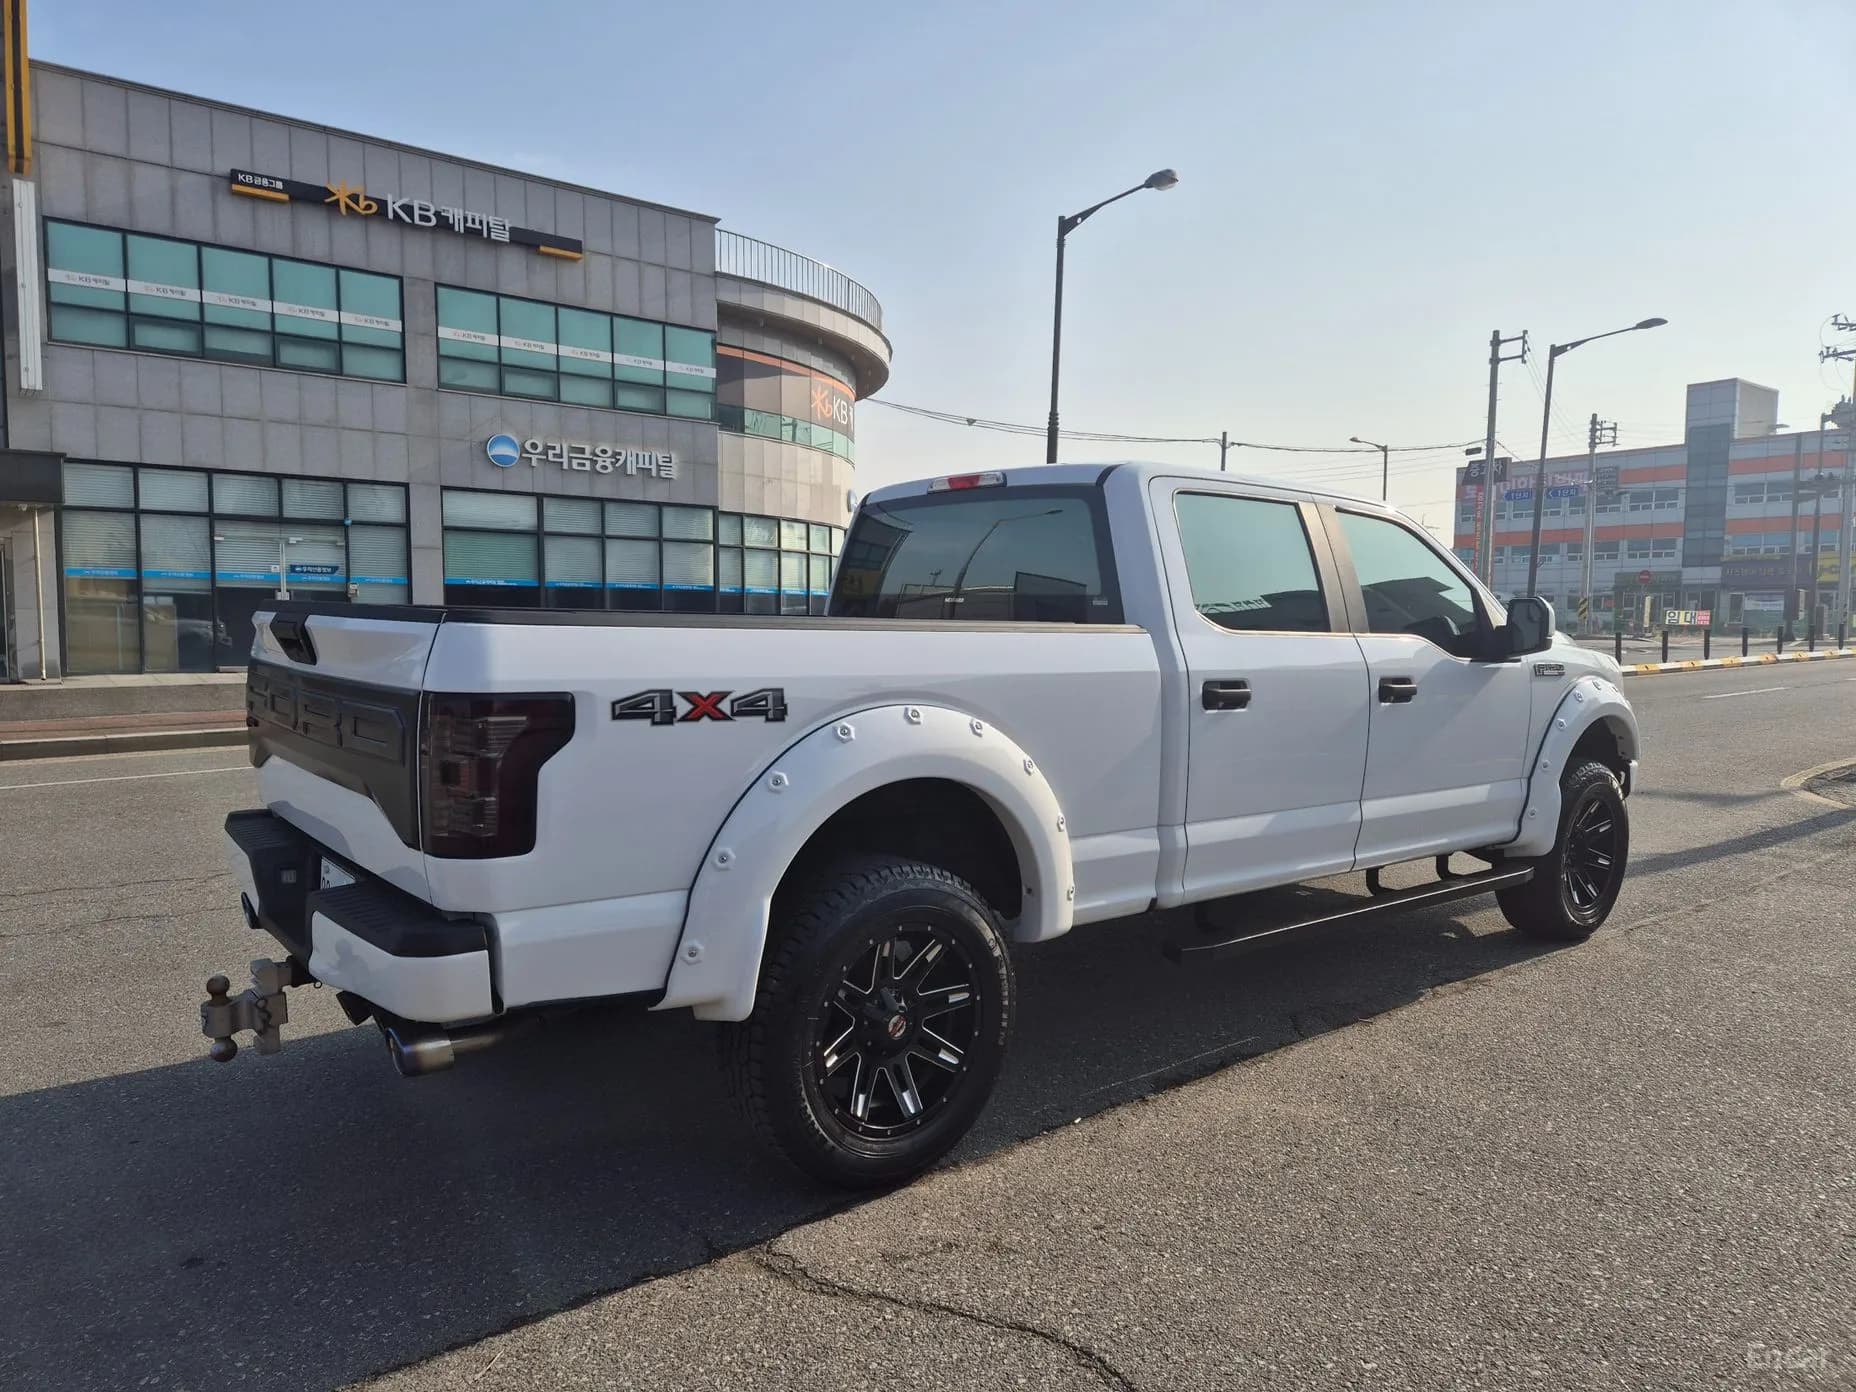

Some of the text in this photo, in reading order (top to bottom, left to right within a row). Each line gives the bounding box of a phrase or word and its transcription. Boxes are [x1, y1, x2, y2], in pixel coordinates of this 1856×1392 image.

[238, 172, 283, 189] KB금융그룹
[387, 193, 510, 243] KB캐피탈
[521, 438, 676, 480] 우리금융캐피탈
